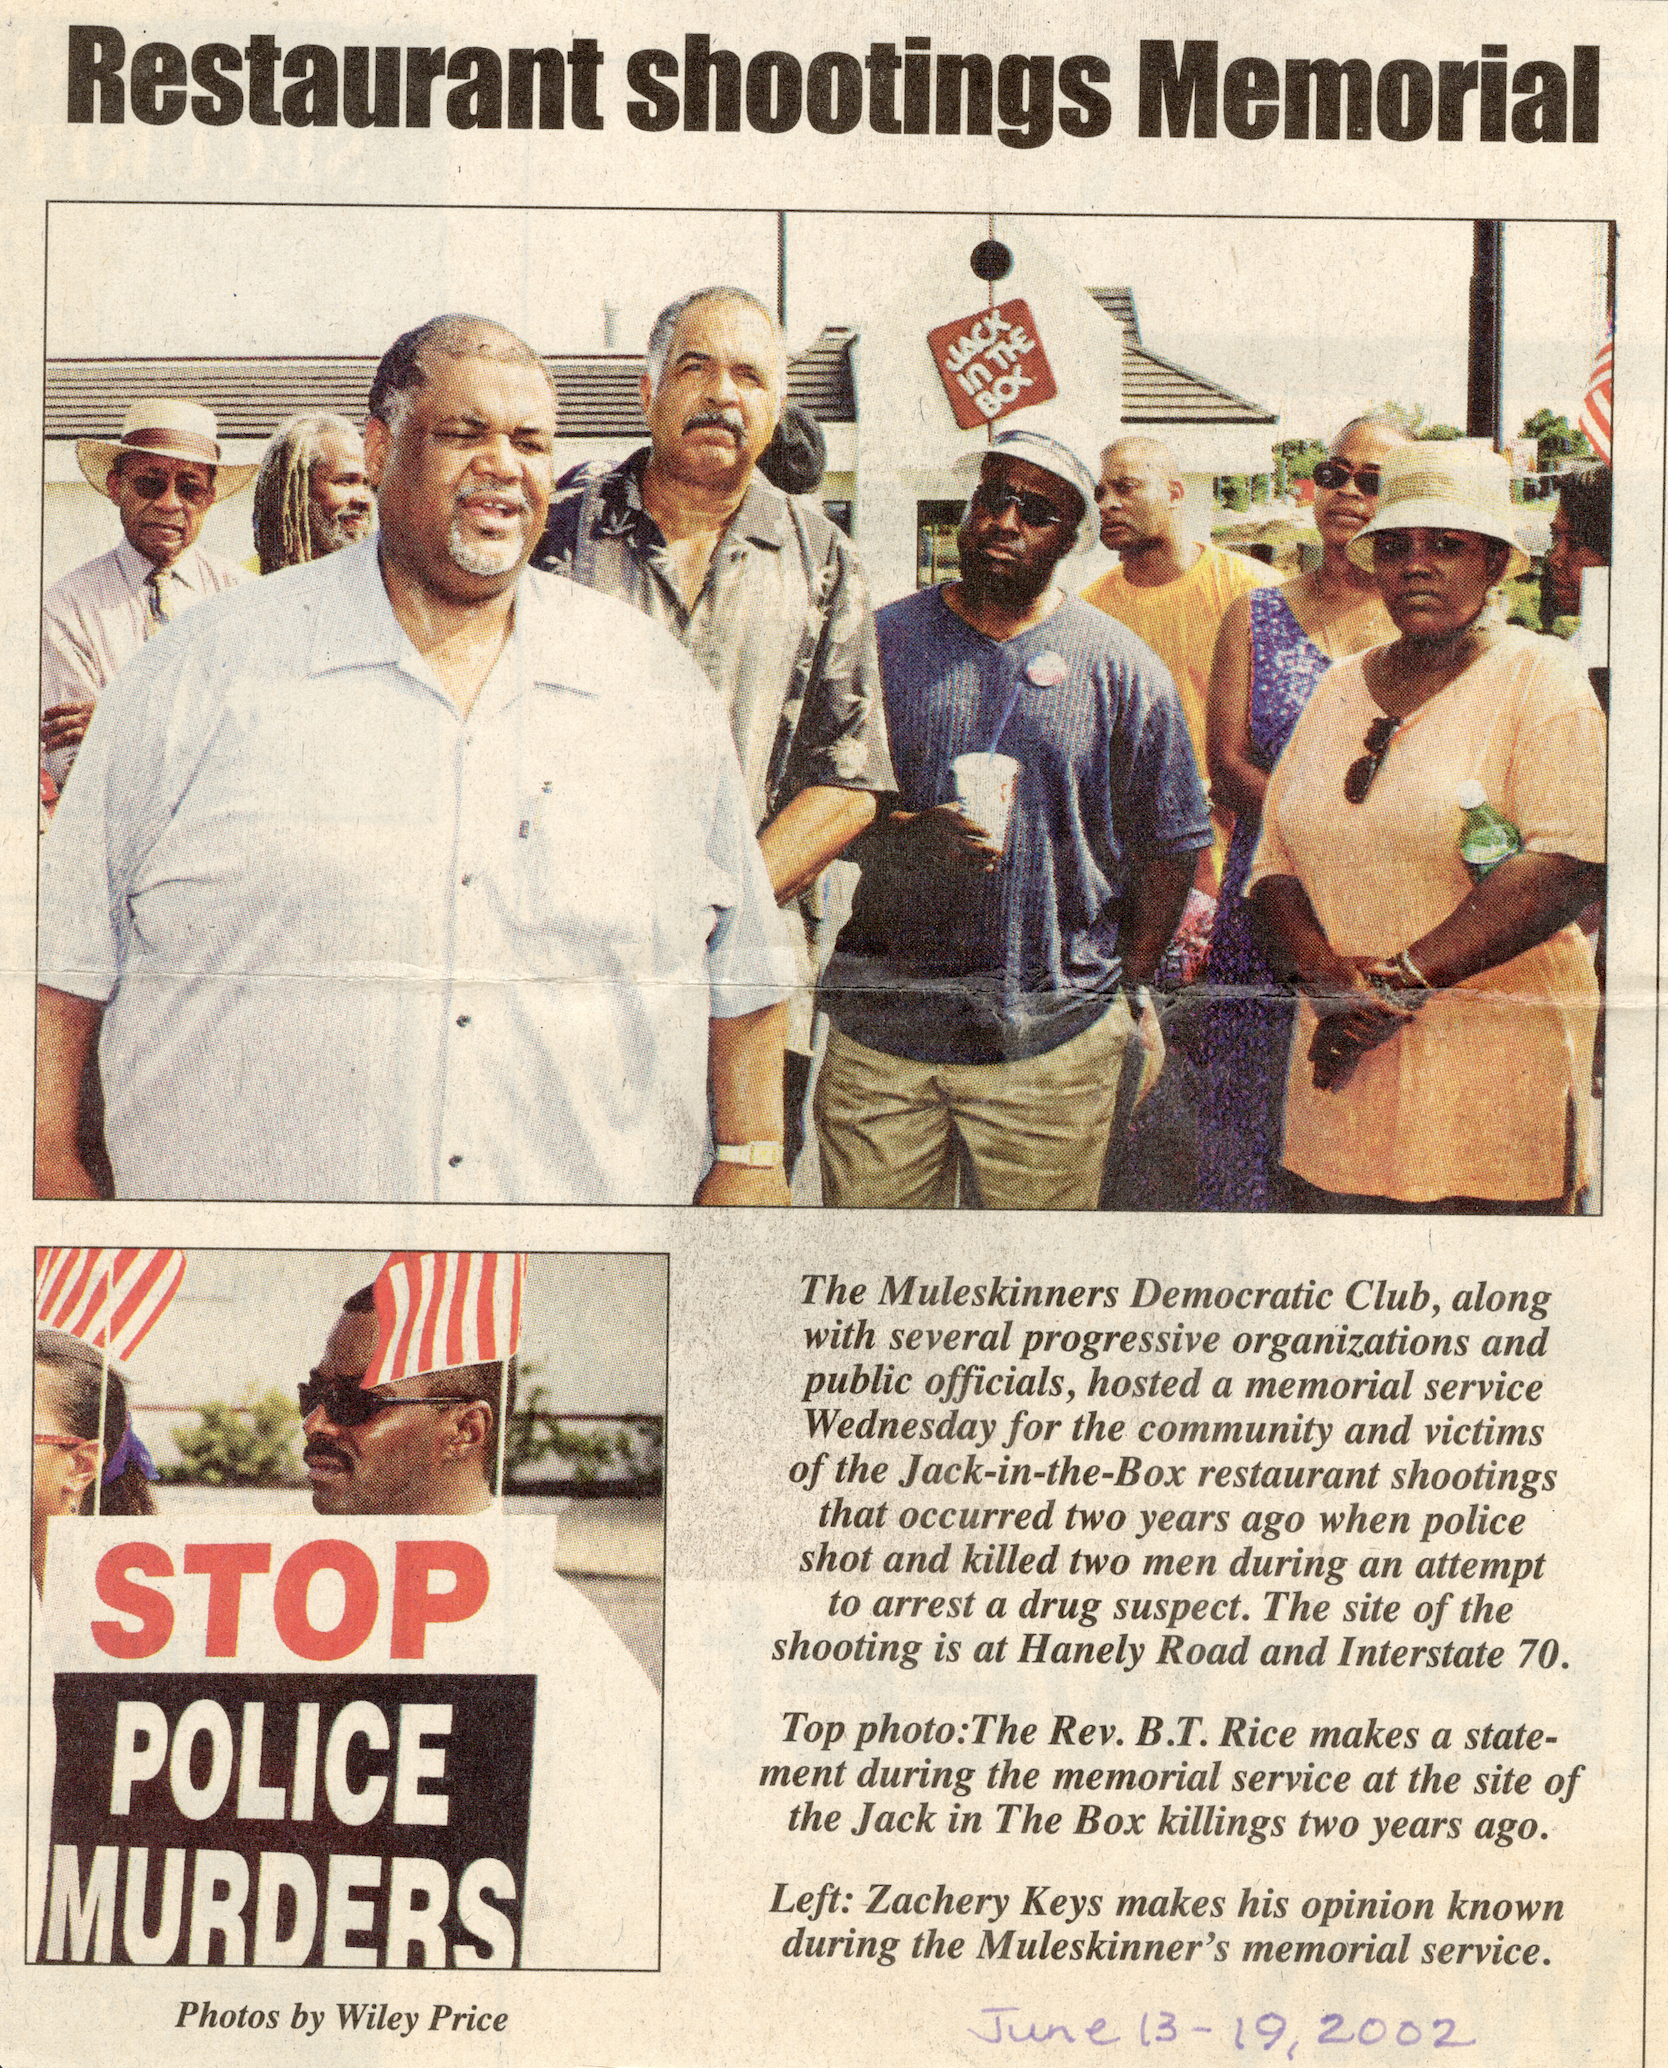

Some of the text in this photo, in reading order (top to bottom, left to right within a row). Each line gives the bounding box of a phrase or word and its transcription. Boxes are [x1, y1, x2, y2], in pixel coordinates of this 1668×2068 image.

[67, 25, 1600, 150] Restaurant shootings Memorial
[946, 309, 1012, 372] JACK
[957, 326, 1036, 396] IN THE
[975, 363, 1035, 418] BOX
[801, 1274, 1552, 1320] The Muleskinners Democratic Club, along
[804, 1318, 1550, 1362] with several progressive organizations and
[801, 1363, 1543, 1404] public officials, hosted a memorial service
[805, 1408, 1542, 1452] Wednesday for the community and victims
[789, 1452, 1555, 1499] of the Jack-in-the-Box restaurant shootings
[819, 1497, 1526, 1542] that occurred two years ago when police
[799, 1541, 1546, 1588] shot and killed two men during an attempt
[90, 1538, 490, 1661] STOP
[828, 1588, 1513, 1629] to arrest a drug suspect. The site of the
[774, 1630, 1569, 1673] shooting is at Hanely Road and Interstate 70.
[783, 1712, 845, 1751] Top
[1049, 1715, 1124, 1746] Rev.
[1136, 1716, 1207, 1747] B.T.
[1220, 1717, 1296, 1748] Rice
[1310, 1717, 1417, 1749] makes
[1431, 1728, 1452, 1749] a
[1467, 1723, 1557, 1751] state-
[110, 1698, 453, 1826] POLICE
[759, 1757, 1581, 1804] ment during the memorial service at the site of
[788, 1800, 1548, 1847] the Jack in The Box killings two years ago.
[46, 1843, 518, 1969] MURDERS
[770, 1882, 1563, 1927] Left: Zachery Keys makes his opinion known
[782, 1927, 1550, 1966] during the Muleskinner's memorial service.
[176, 2001, 508, 2032] Photos by Wiley Price
[967, 2007, 1120, 2047] June
[1317, 2013, 1477, 2047] 2002
